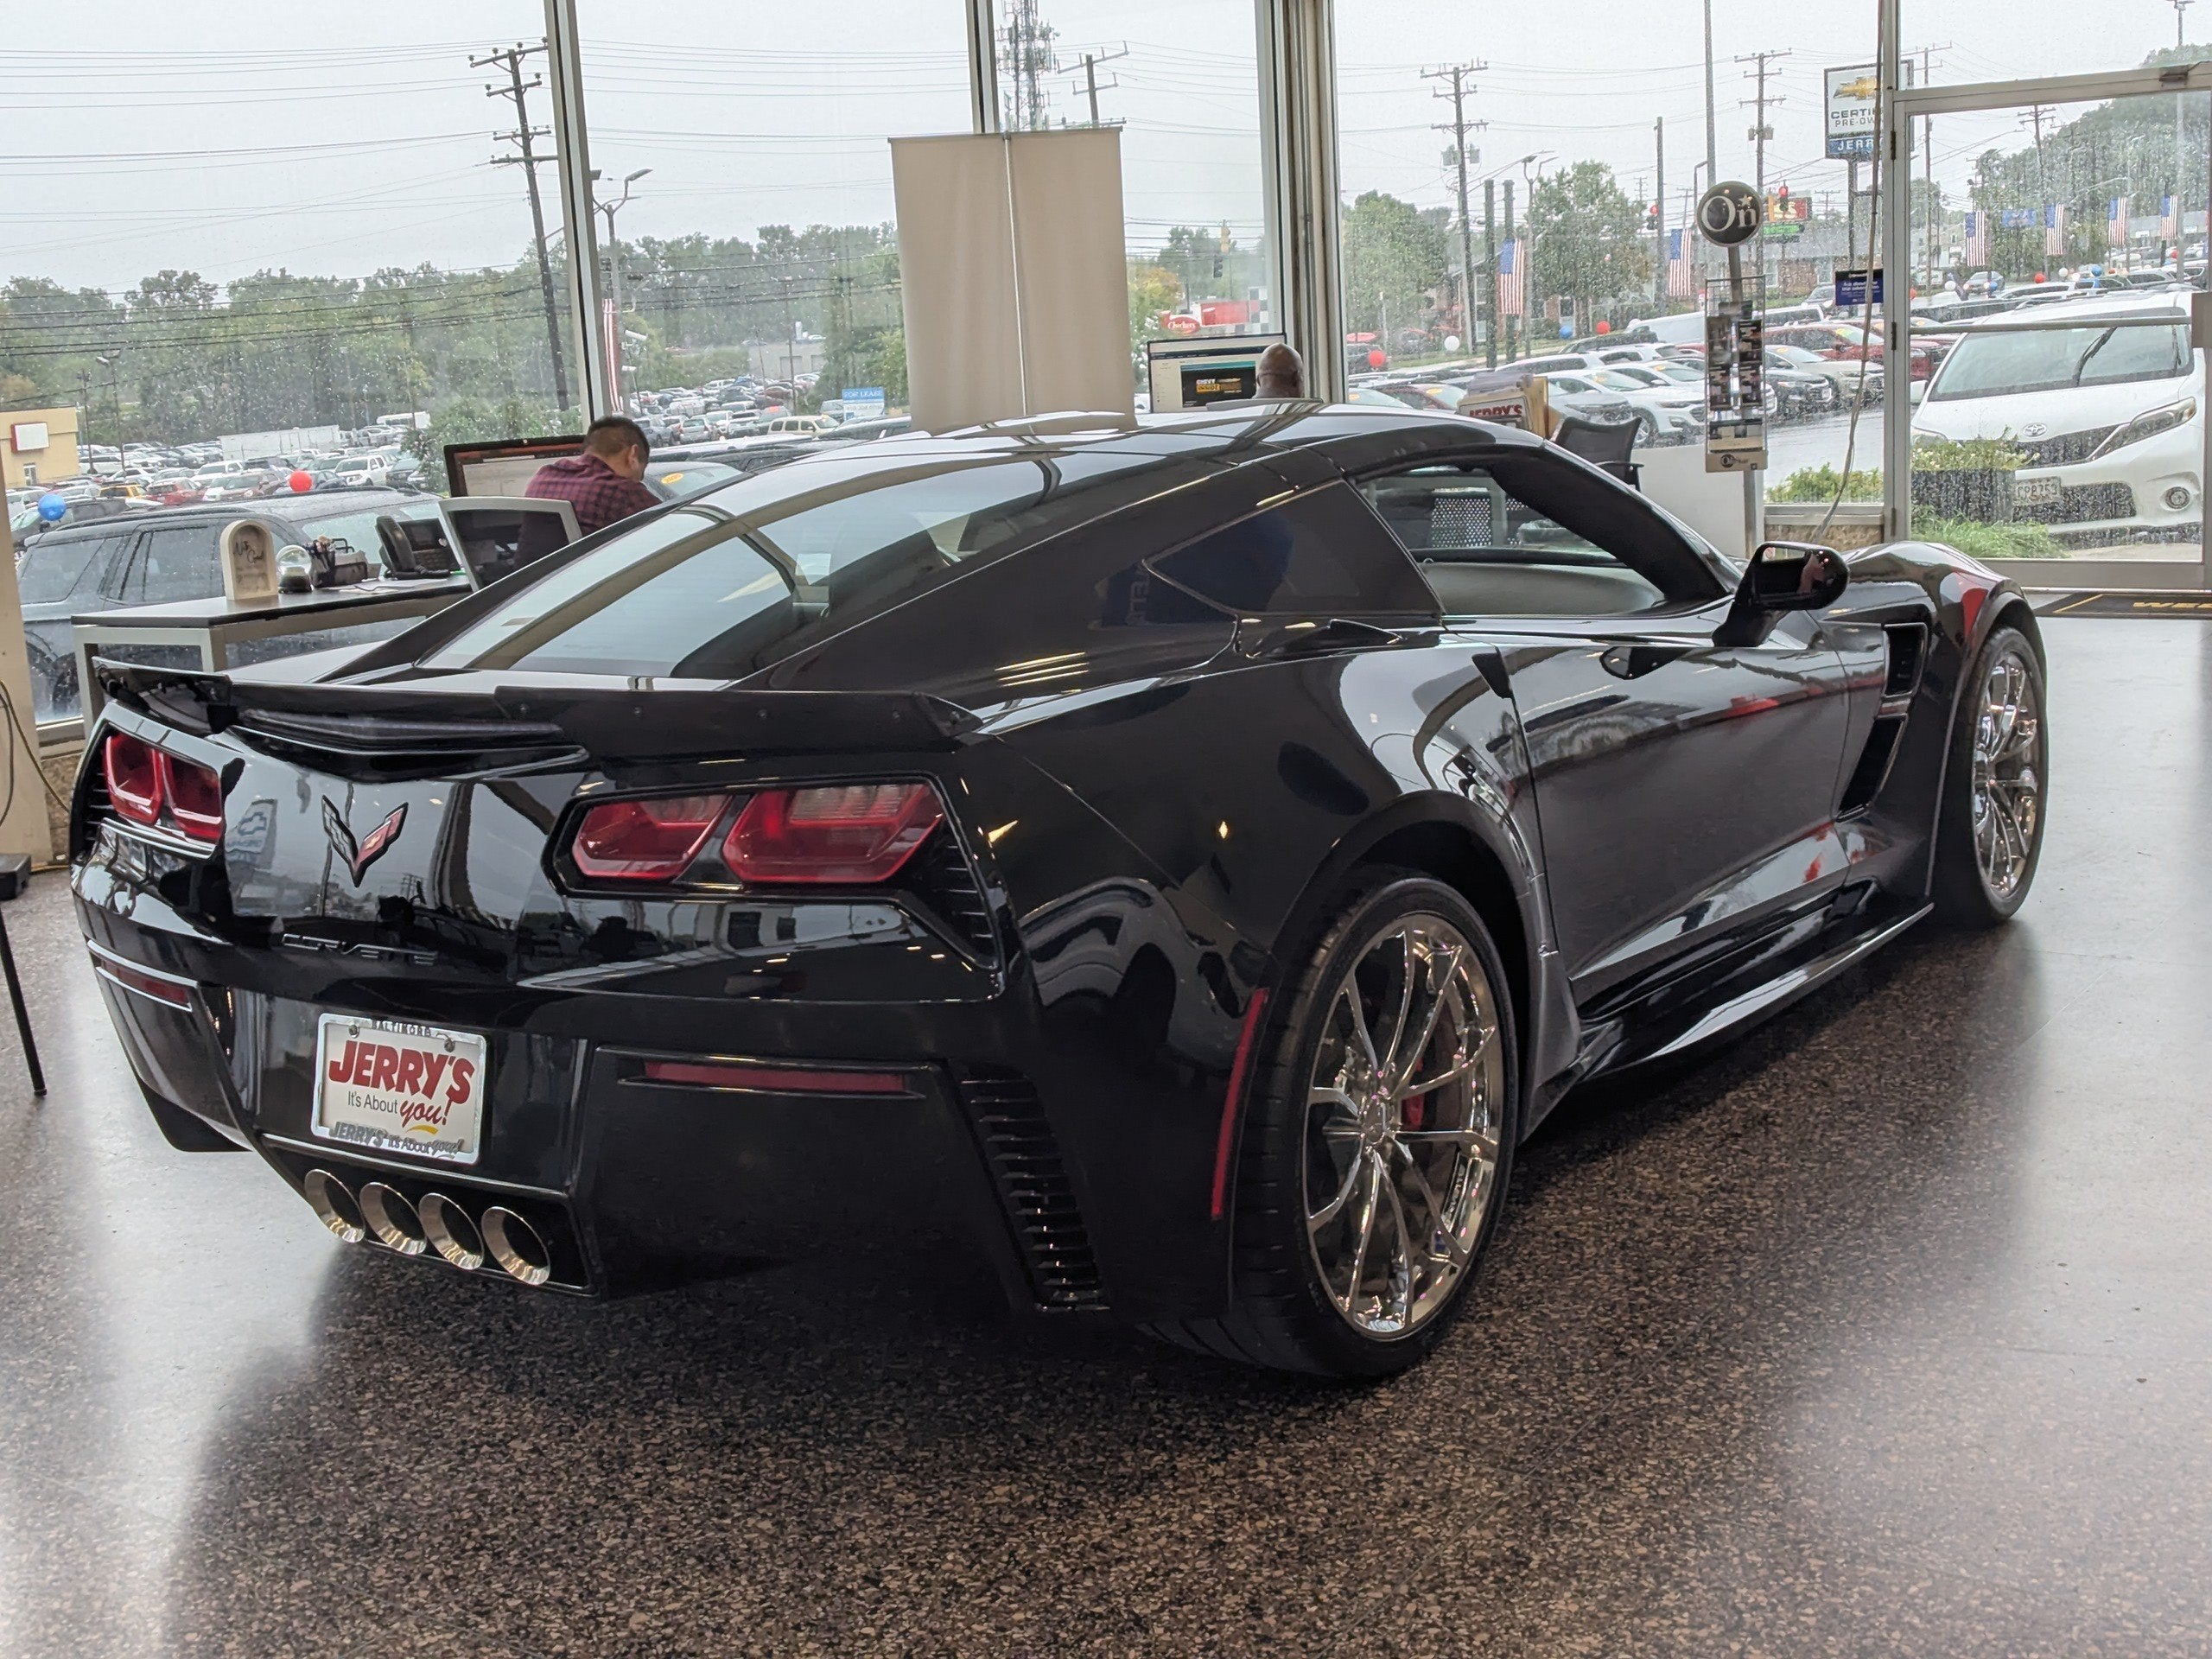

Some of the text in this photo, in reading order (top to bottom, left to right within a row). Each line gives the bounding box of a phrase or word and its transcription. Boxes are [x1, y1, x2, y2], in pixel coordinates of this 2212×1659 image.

[1701, 195, 1758, 232] On
[328, 1039, 475, 1105] JERRY'S
[347, 1090, 452, 1128] It's About you!
[328, 1121, 388, 1147] JERRY'S
